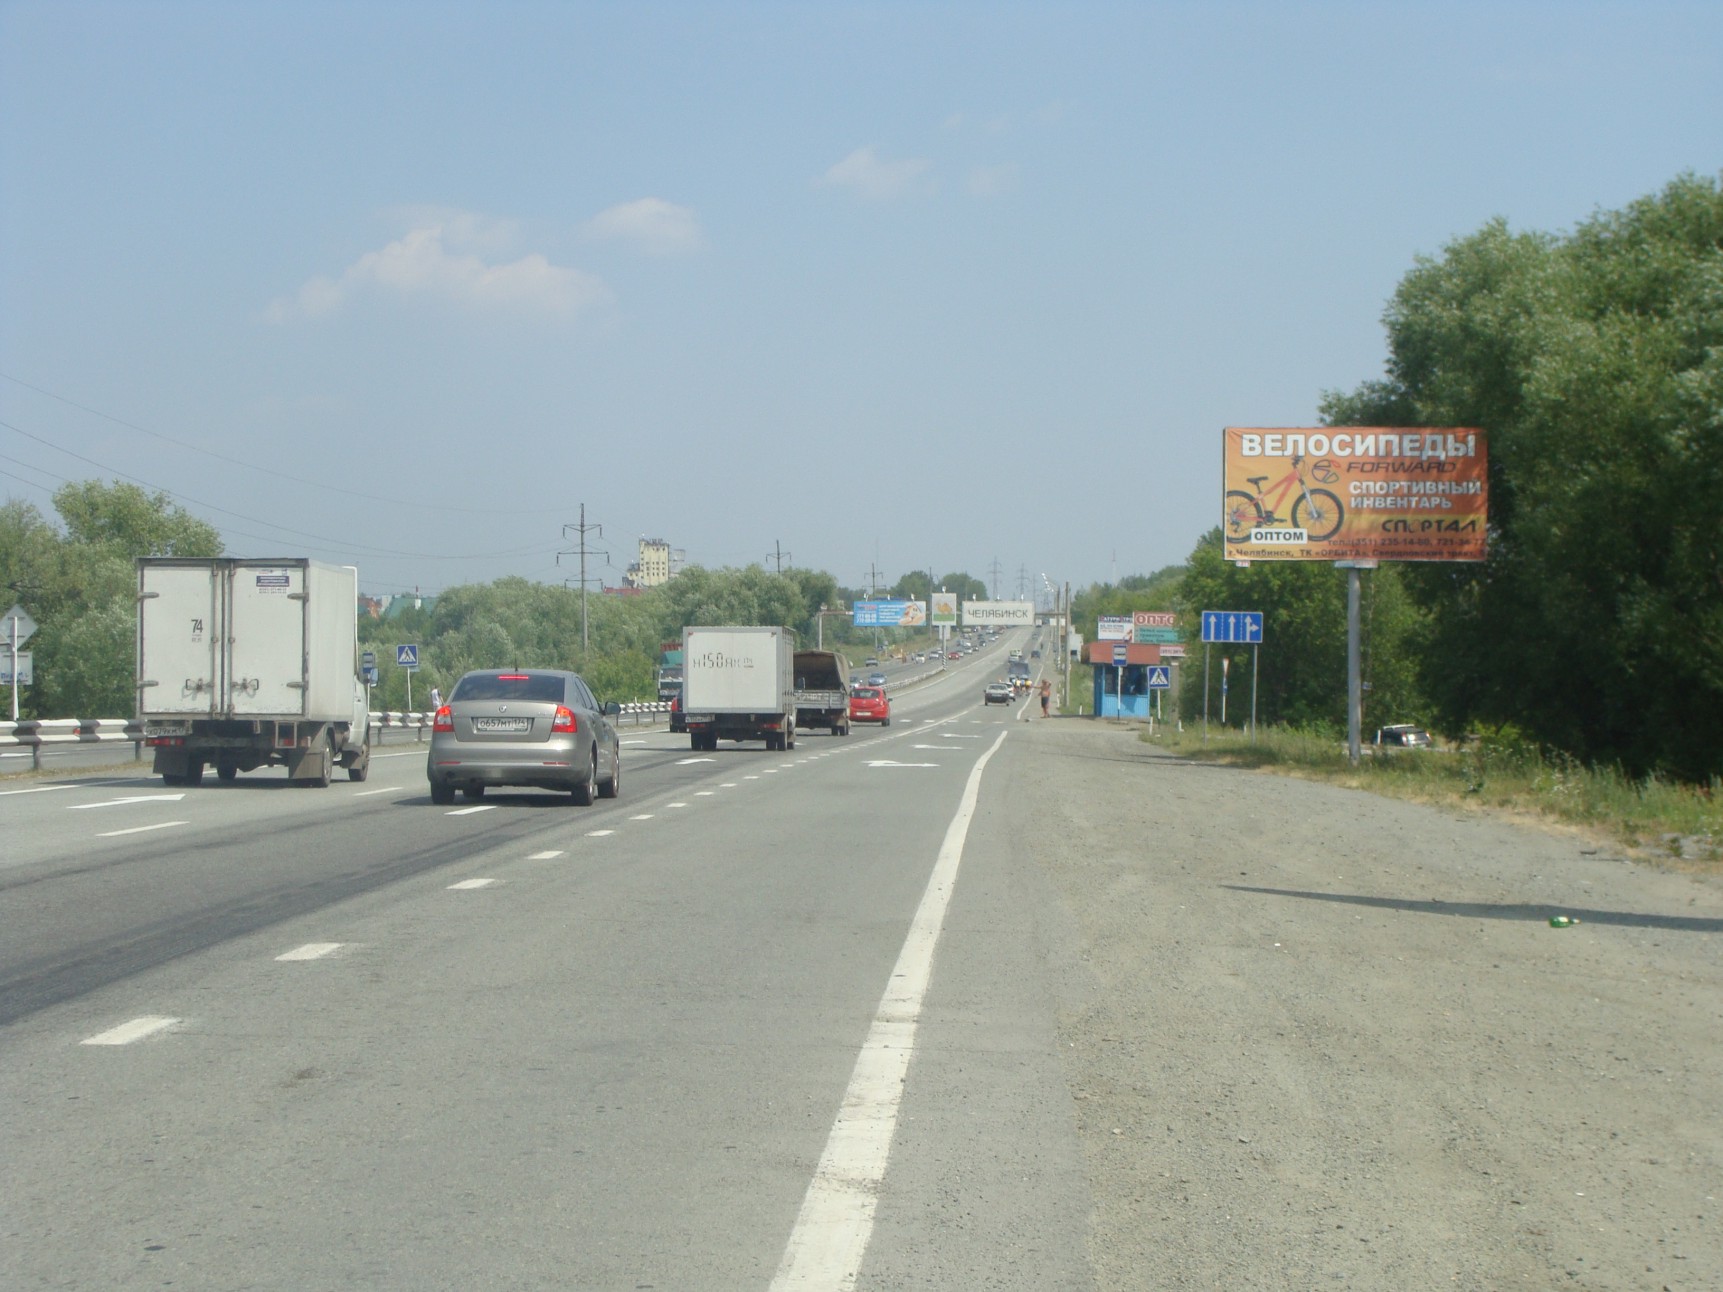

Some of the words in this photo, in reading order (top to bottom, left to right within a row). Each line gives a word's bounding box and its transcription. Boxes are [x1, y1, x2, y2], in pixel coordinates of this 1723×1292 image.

[1241, 434, 1476, 461] ВЕЛОСИПЕДЫ
[1347, 462, 1457, 473] FORWARD
[1350, 480, 1482, 494] СПОРТИВНЫЙ
[1350, 497, 1453, 508] ИНВЕНТАРЬ
[1254, 531, 1304, 541] ОПТОМ
[968, 608, 1028, 619] ЧЕЛЯБИНСК
[191, 619, 203, 633] 74
